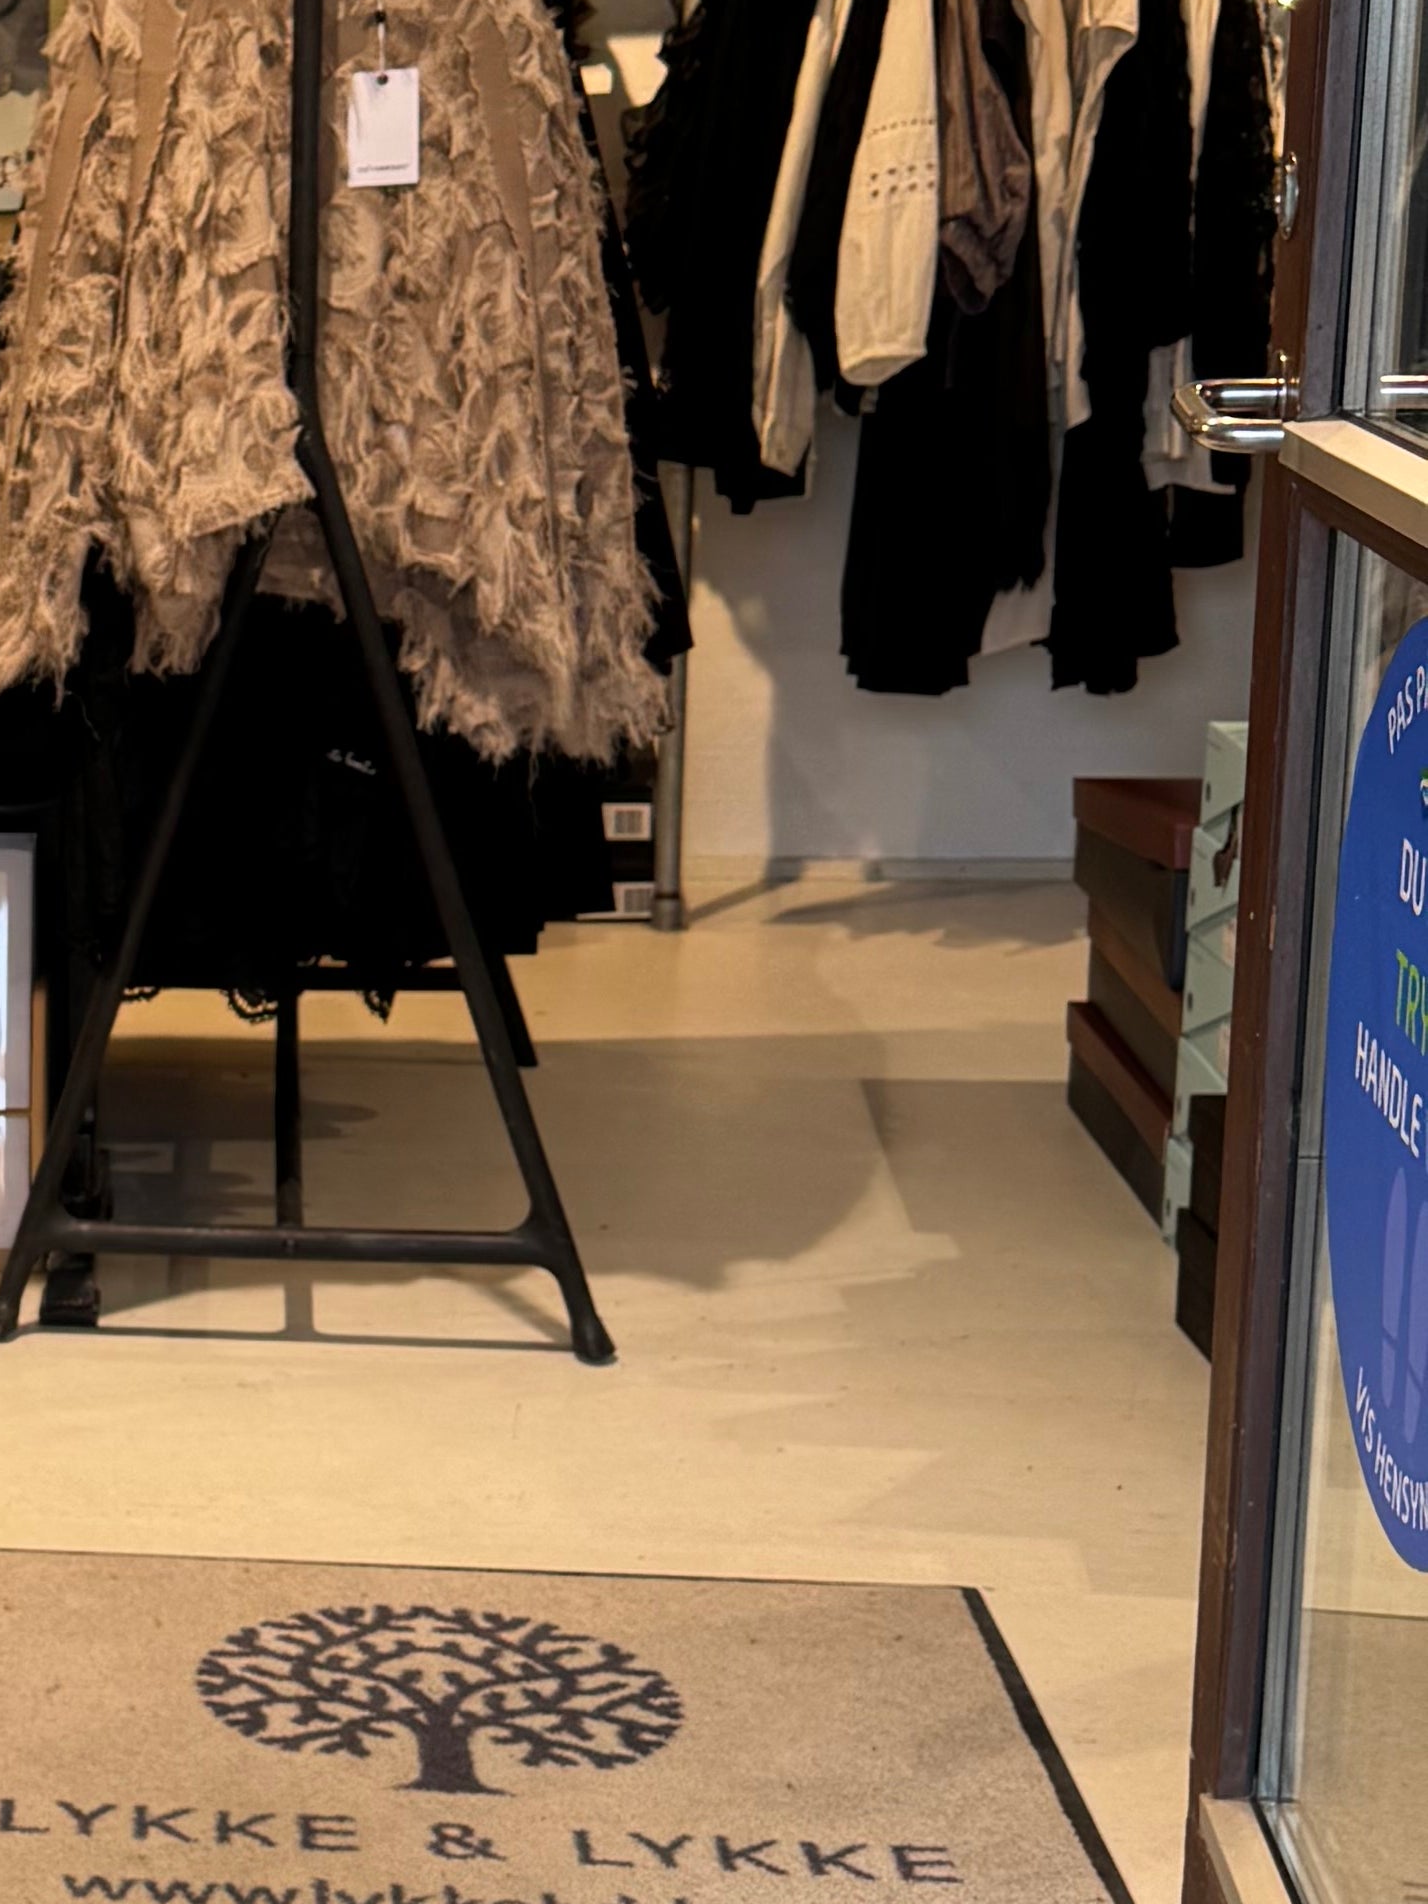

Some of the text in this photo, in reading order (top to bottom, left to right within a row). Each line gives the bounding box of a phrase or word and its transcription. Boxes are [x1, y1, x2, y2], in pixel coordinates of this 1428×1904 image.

[1387, 675, 1414, 756] PAS
[1354, 1021, 1423, 1159] HANDLE
[1355, 1366, 1376, 1453] VIS
[430, 1820, 510, 1863] &
[575, 1830, 965, 1886] LYKKE
